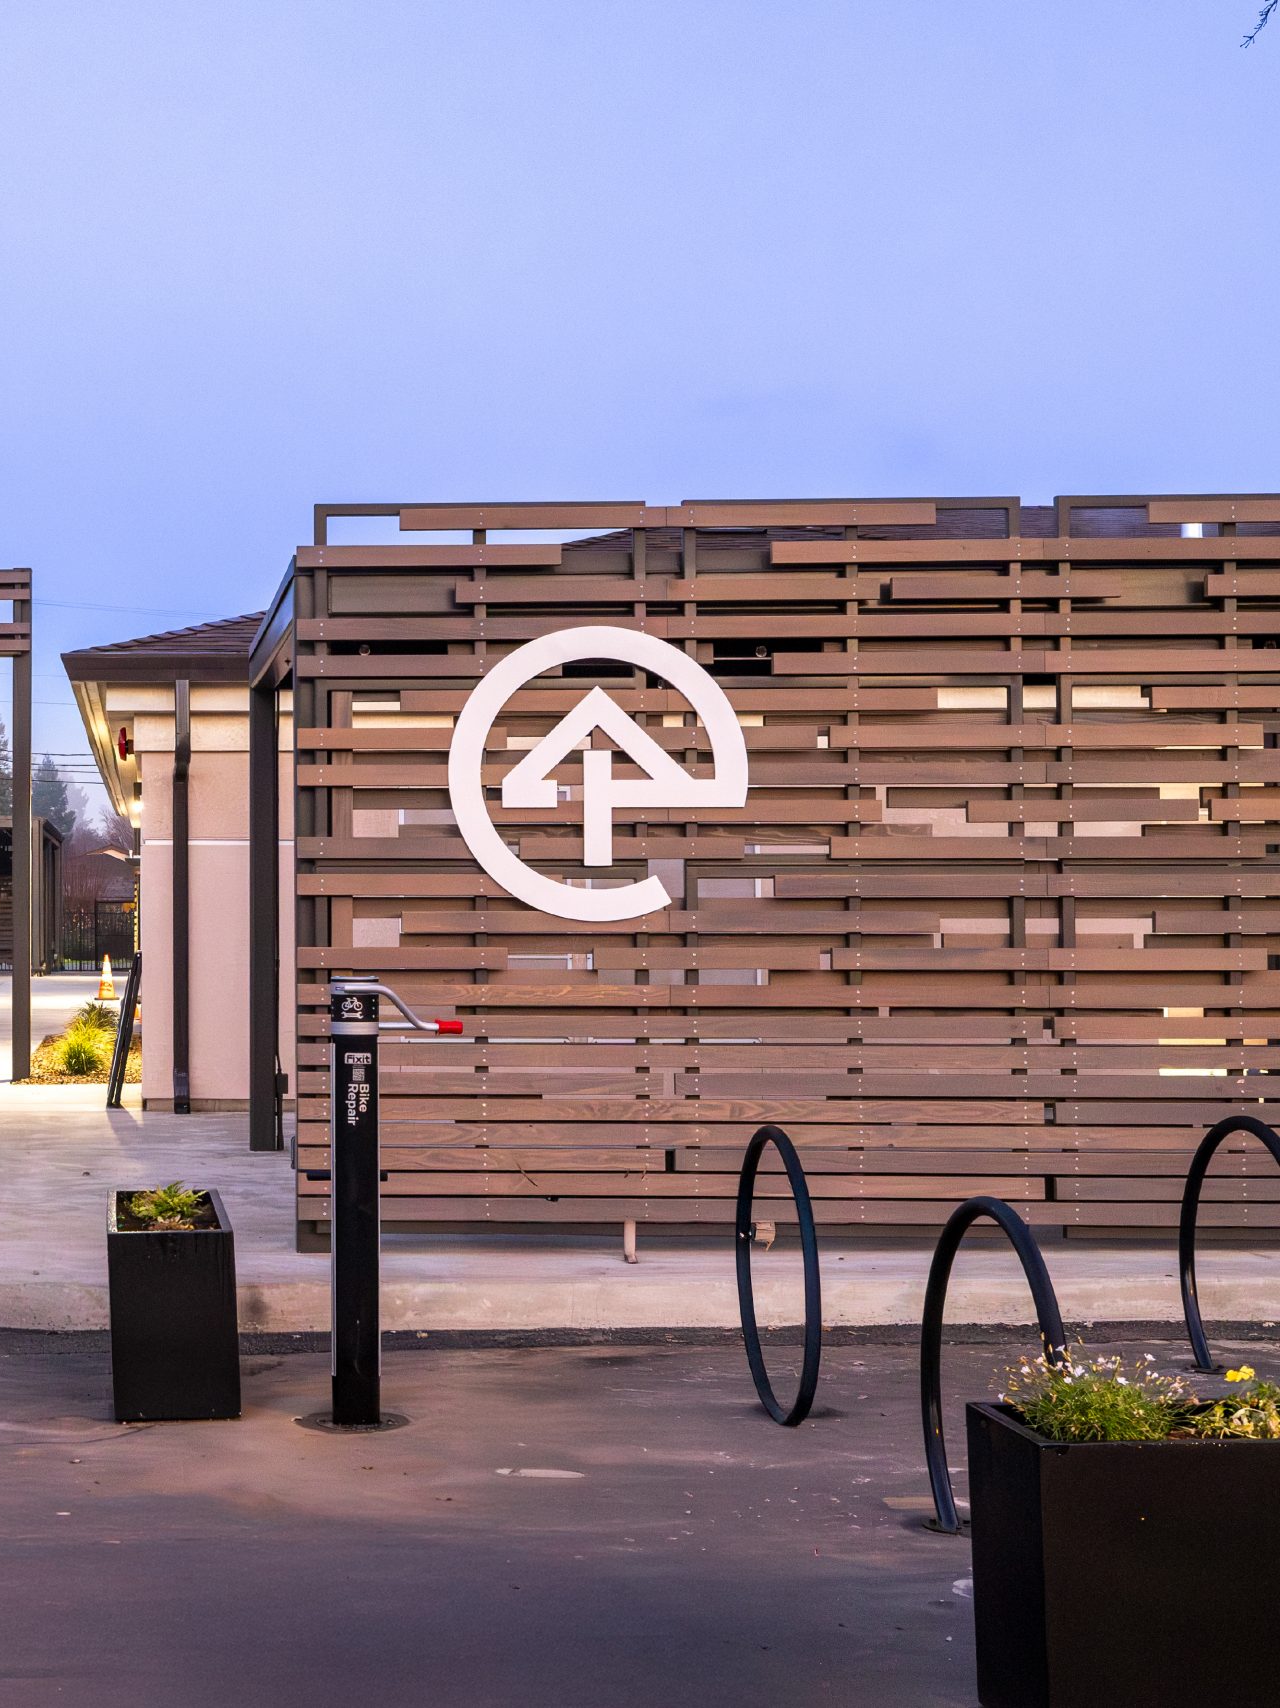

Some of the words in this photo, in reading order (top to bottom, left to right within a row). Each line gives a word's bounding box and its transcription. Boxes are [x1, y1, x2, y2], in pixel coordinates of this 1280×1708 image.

[346, 1054, 371, 1064] Fixit
[345, 1083, 359, 1127] Repair
[359, 1083, 370, 1113] Bike
